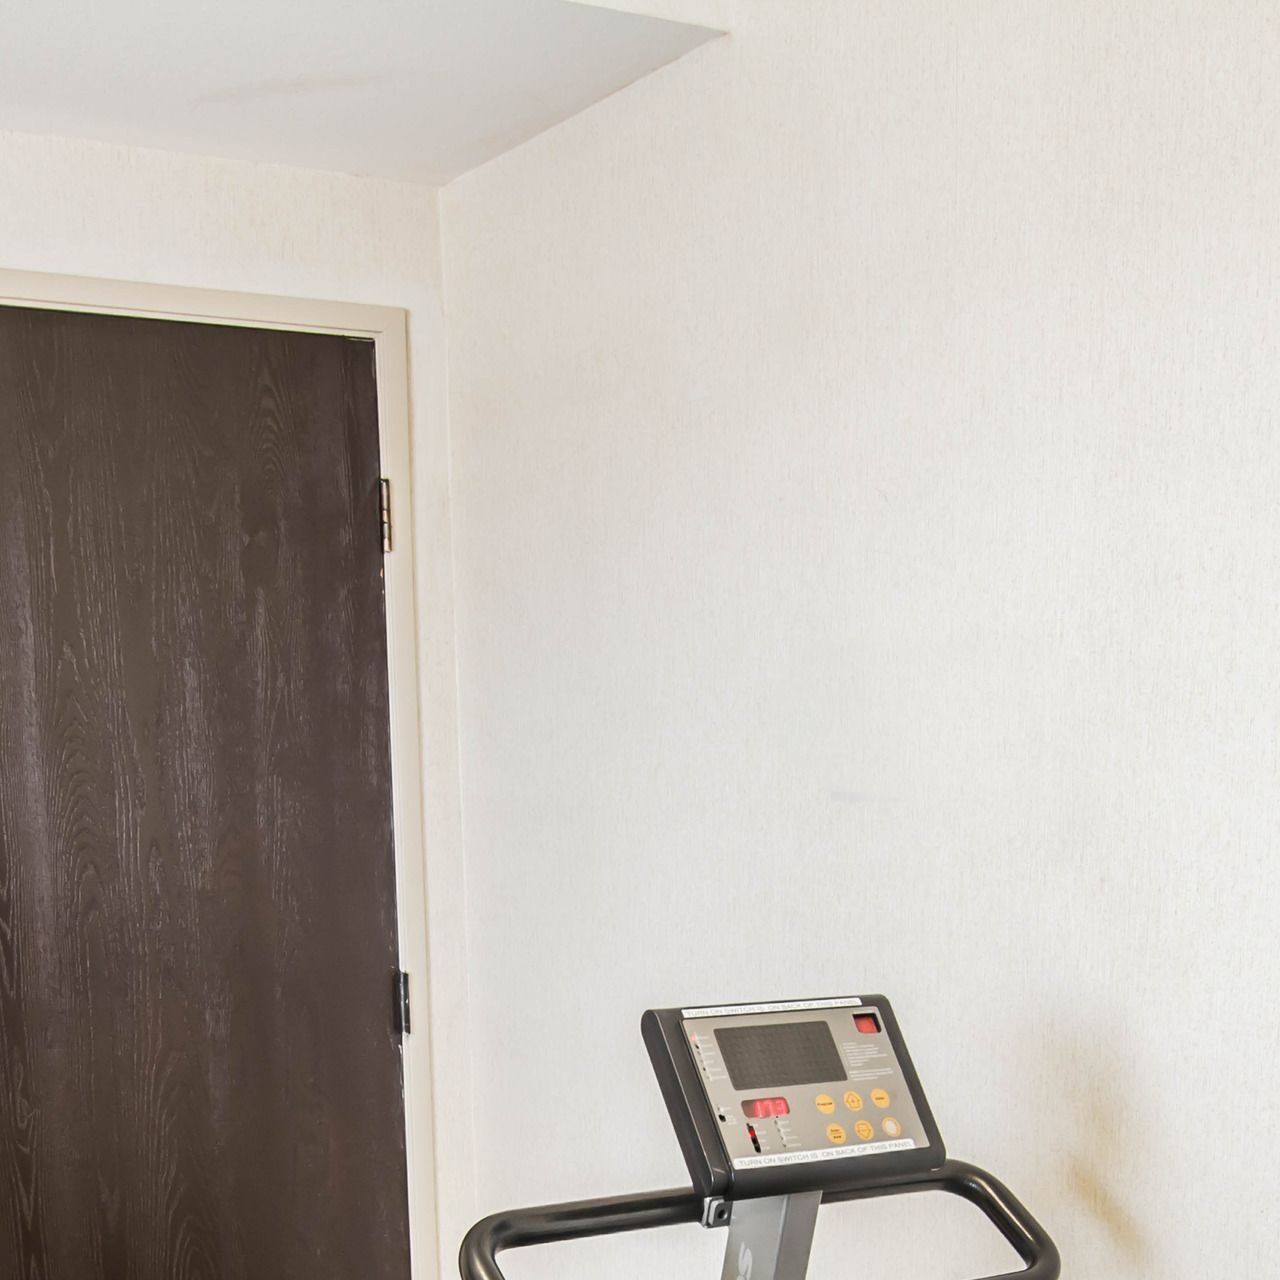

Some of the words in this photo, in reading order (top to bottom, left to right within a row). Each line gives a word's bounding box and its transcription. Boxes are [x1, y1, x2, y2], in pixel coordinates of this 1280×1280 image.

[739, 1158, 762, 1167] TURN
[779, 1154, 809, 1163] SWITCH
[822, 1151, 833, 1159] ON
[836, 1148, 855, 1157] BACK
[871, 1145, 886, 1153] THIS
[888, 1141, 912, 1151] PANEL
